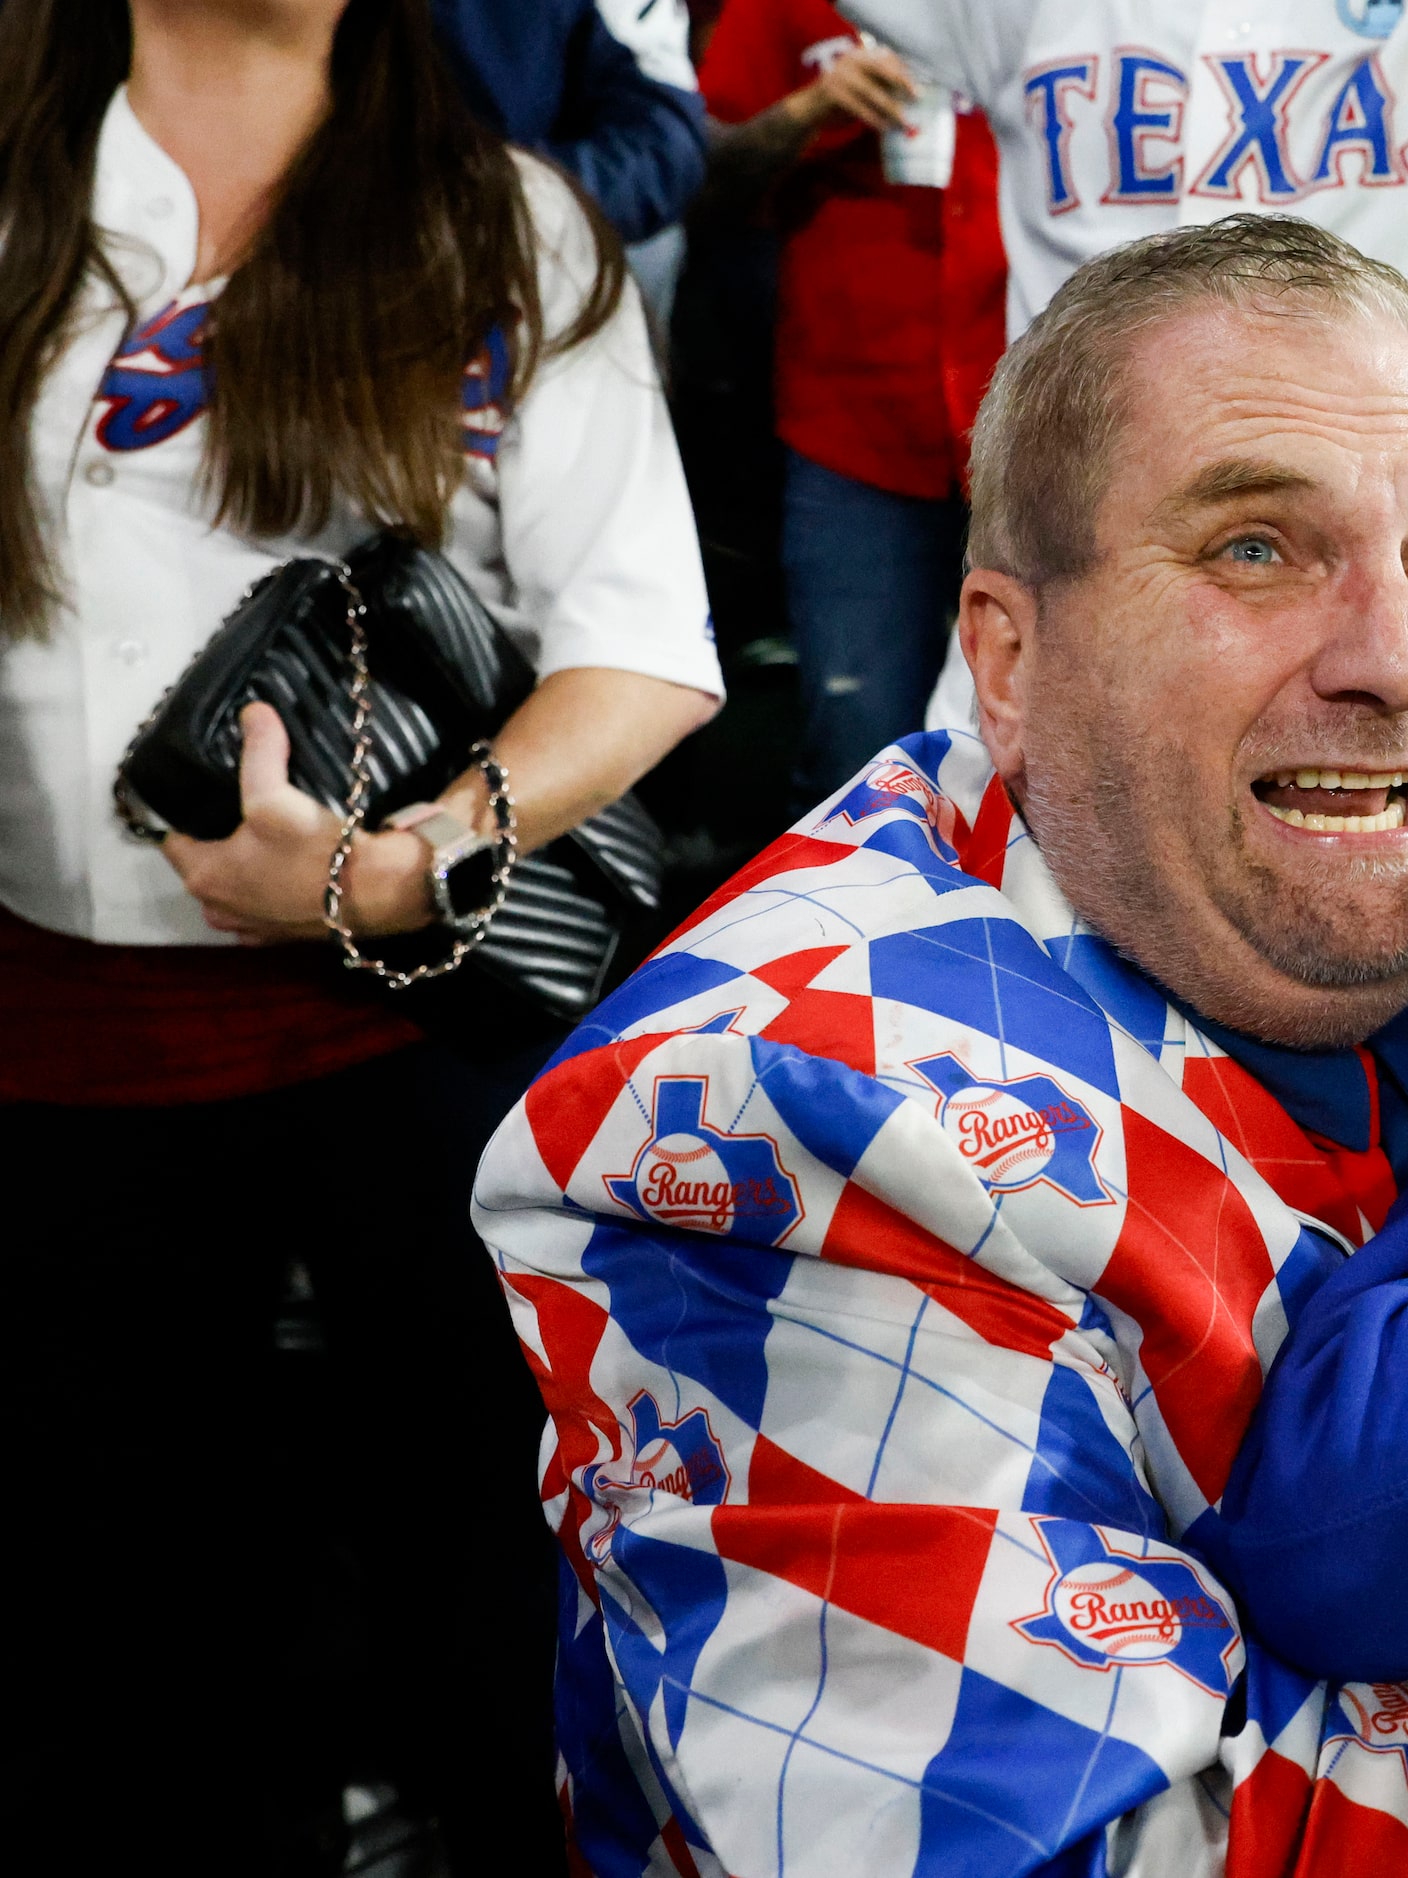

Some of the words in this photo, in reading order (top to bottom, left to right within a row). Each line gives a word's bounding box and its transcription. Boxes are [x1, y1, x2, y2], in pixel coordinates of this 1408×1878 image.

[960, 1101, 1091, 1159] Rangers
[642, 1162, 792, 1227] Rangers
[1069, 1591, 1228, 1639] Rangers
